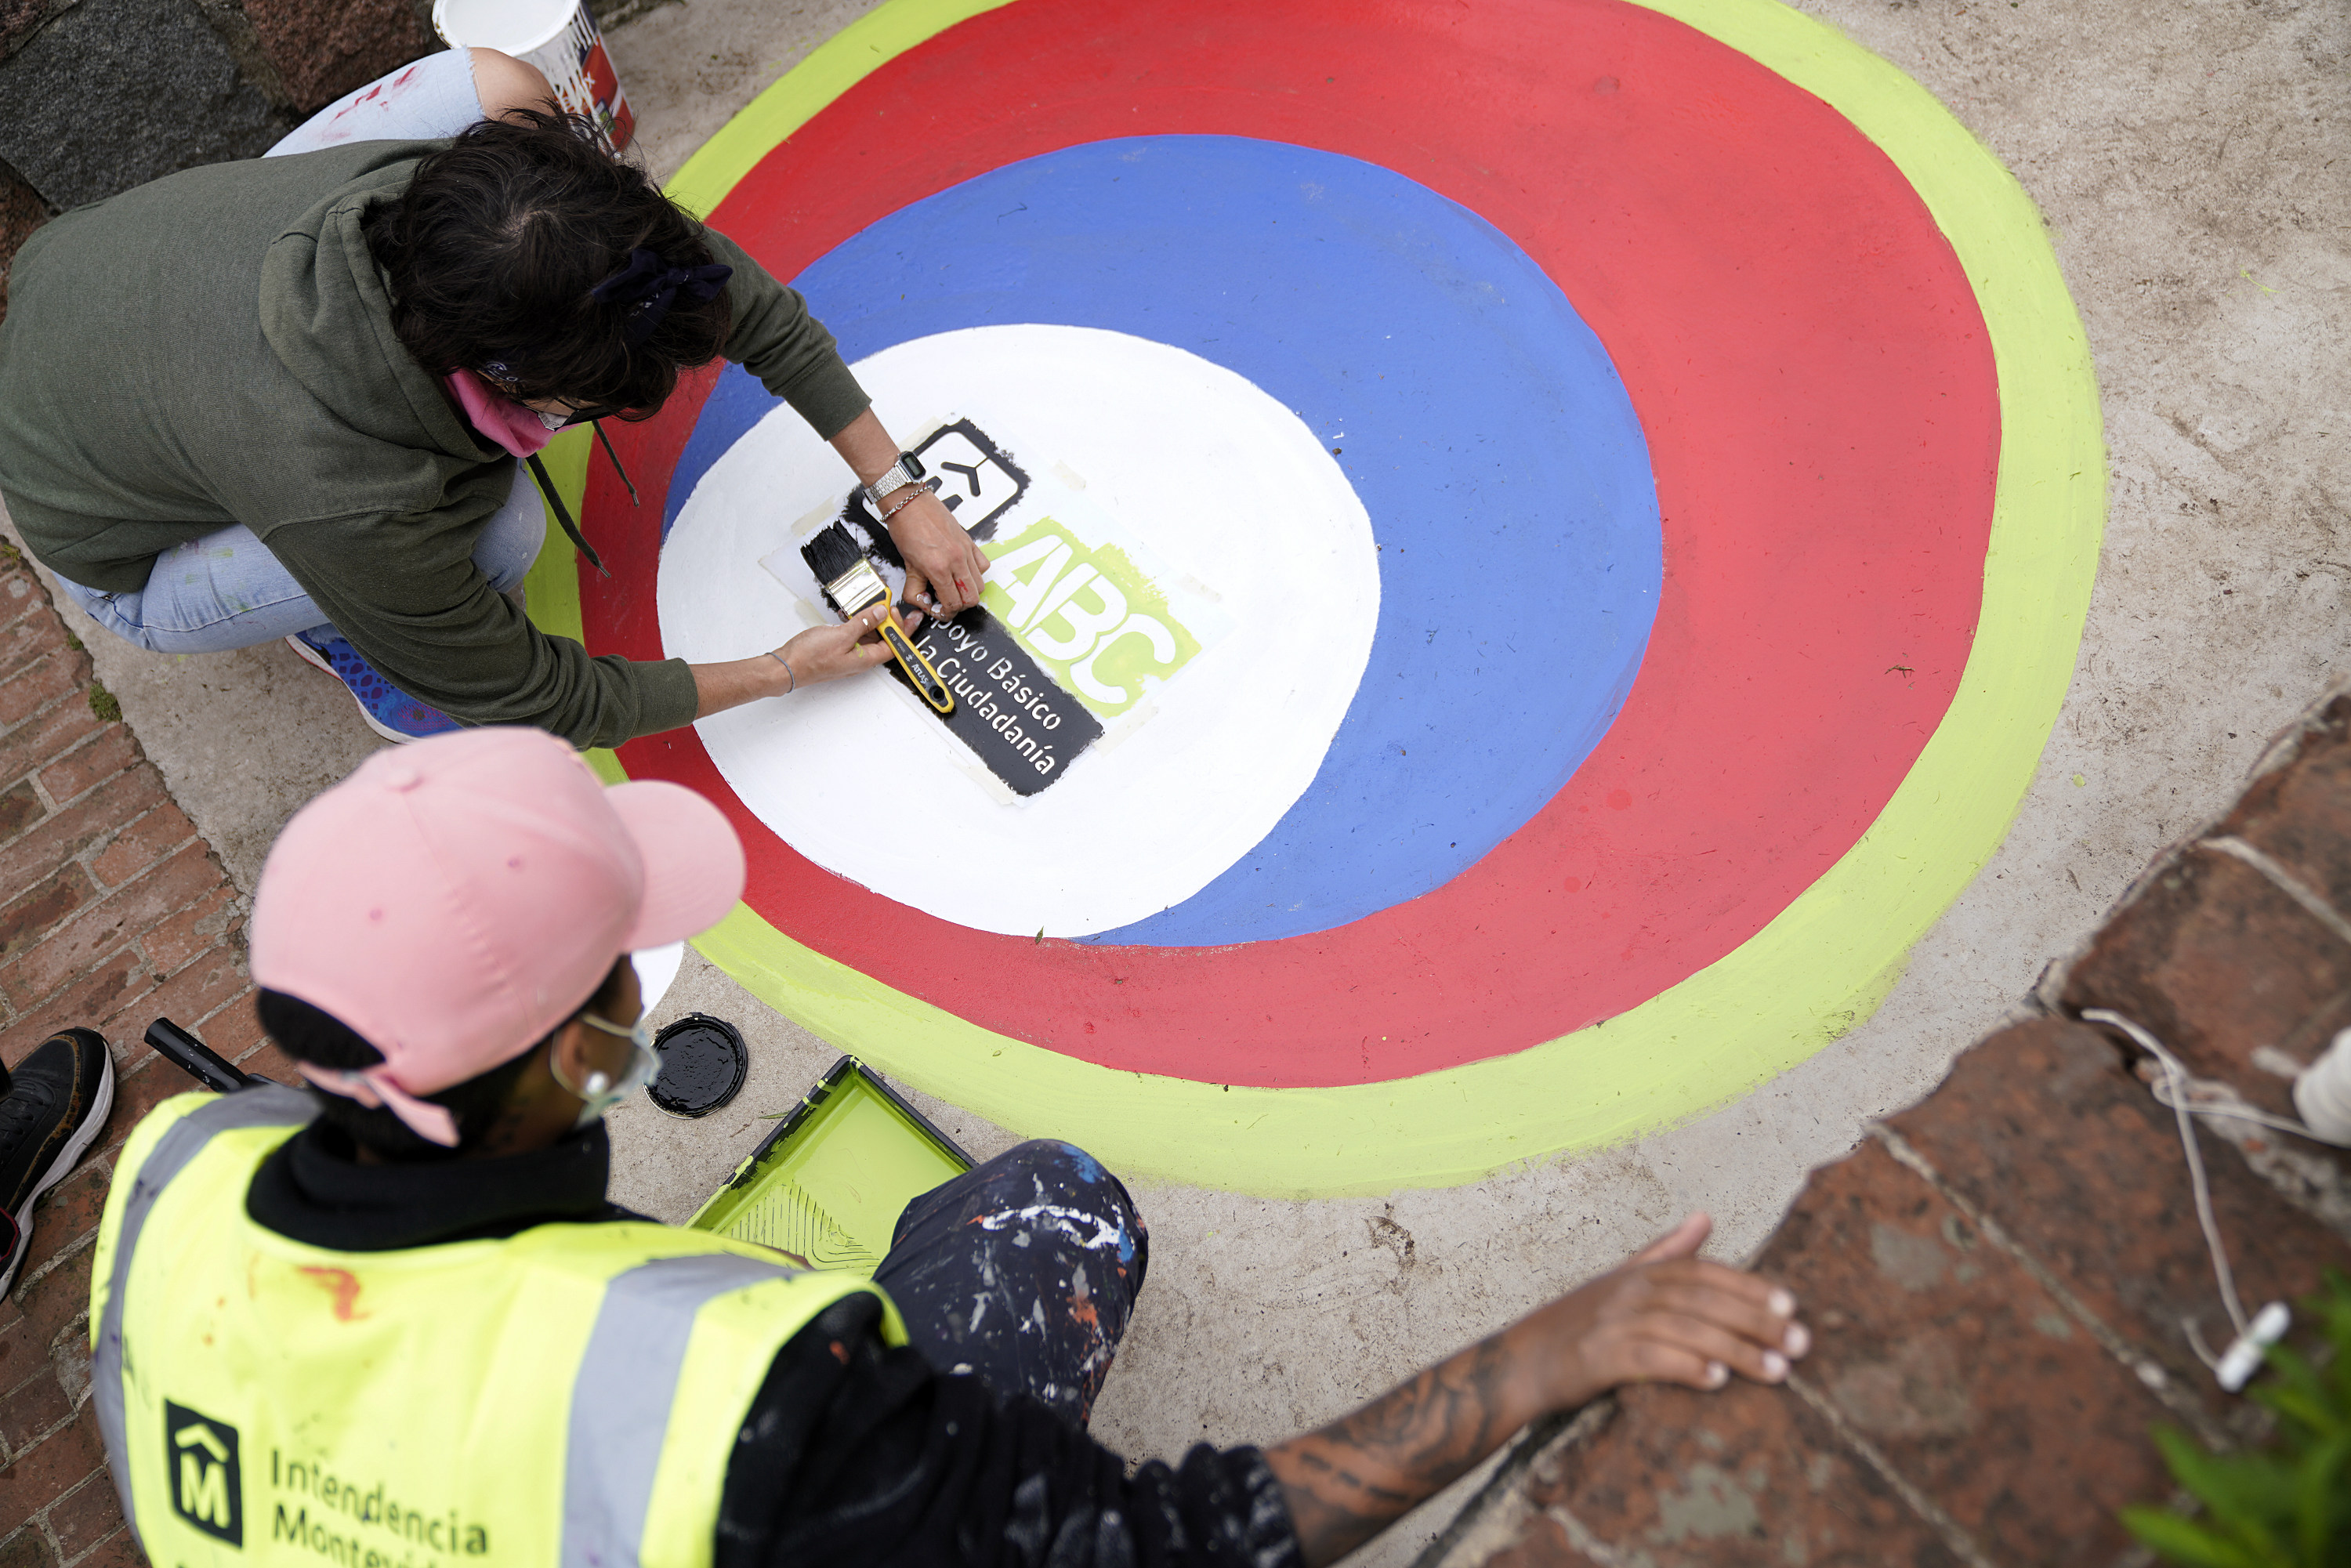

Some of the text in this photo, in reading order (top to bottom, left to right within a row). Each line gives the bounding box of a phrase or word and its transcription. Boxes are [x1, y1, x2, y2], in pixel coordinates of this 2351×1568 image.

[911, 664, 929, 685] ATLAS
[929, 617, 1061, 730] poyo Básico
[983, 534, 1176, 704] ABC
[915, 635, 1056, 776] la Ciudadanía
[271, 1447, 488, 1556] Intendencia
